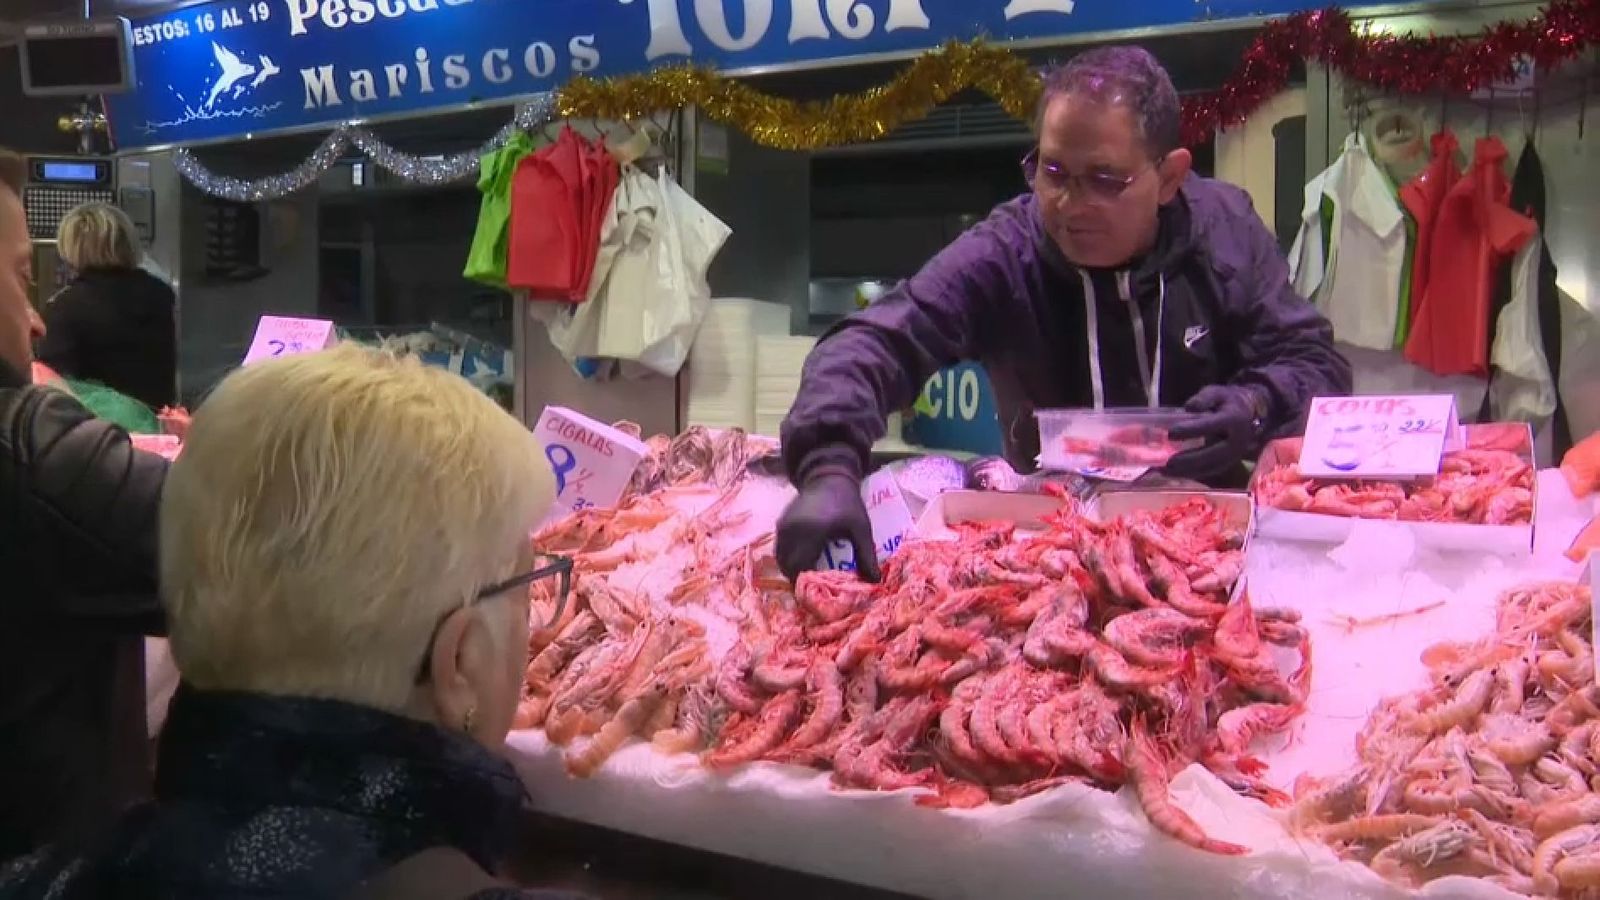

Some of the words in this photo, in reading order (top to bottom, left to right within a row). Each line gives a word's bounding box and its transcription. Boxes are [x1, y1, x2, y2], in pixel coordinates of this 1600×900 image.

[132, 19, 190, 46] ESTOS:
[195, 13, 215, 33] 16
[222, 8, 243, 29] AL
[249, 2, 270, 23] 19
[285, 0, 474, 36] Pesc
[299, 34, 601, 110] Mariscos
[546, 417, 613, 456] CIGALAS
